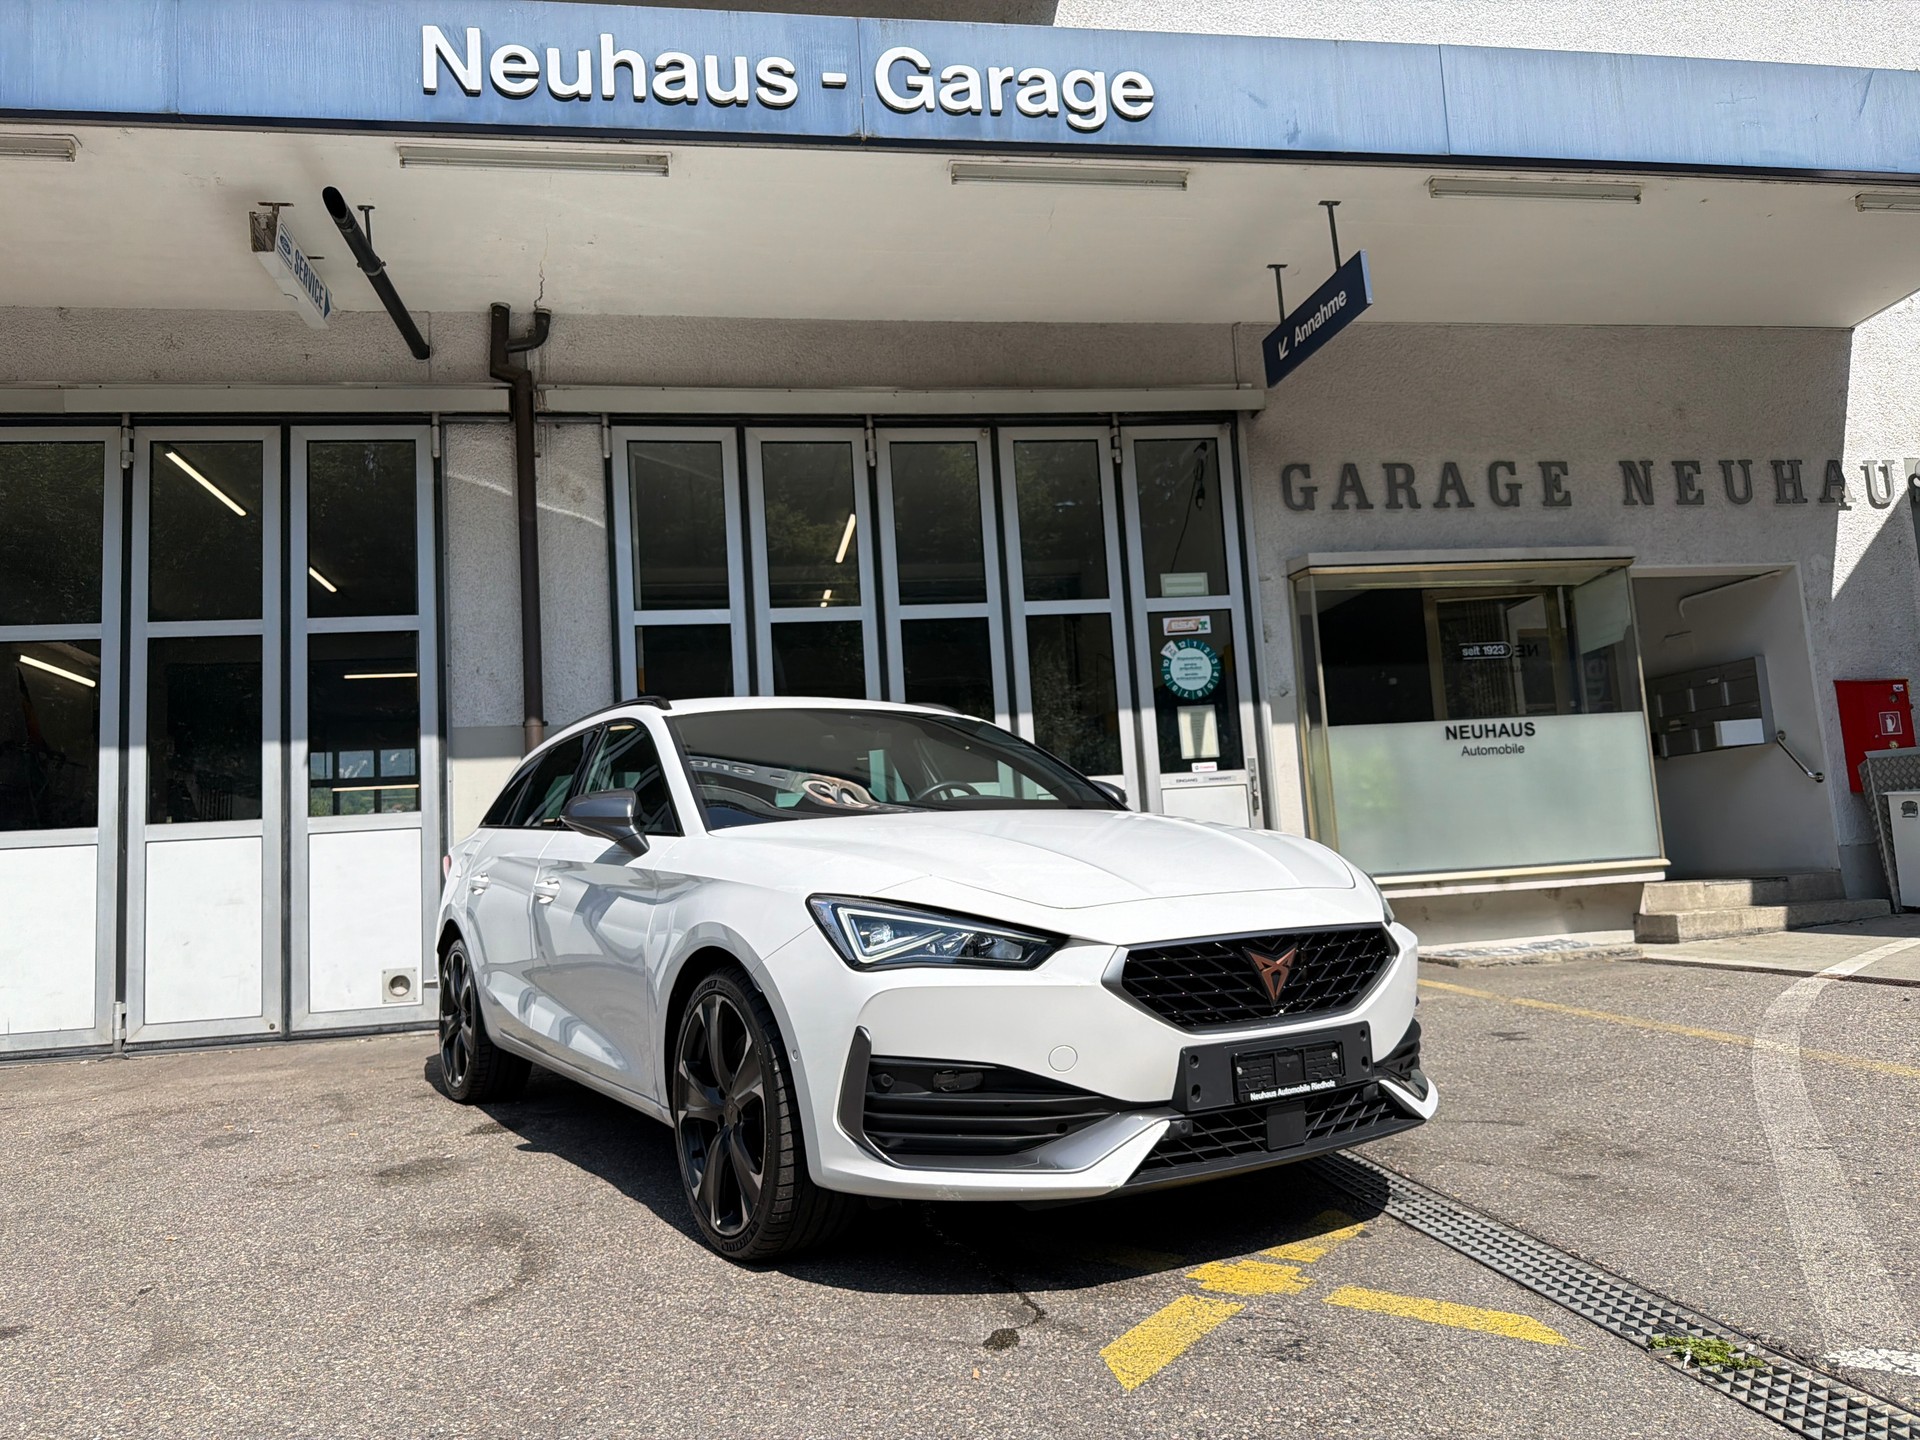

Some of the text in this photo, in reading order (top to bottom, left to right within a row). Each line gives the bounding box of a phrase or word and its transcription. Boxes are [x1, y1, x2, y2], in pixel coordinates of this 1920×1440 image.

[421, 25, 799, 108] Neuhaus
[874, 46, 1156, 132] Garage
[294, 249, 324, 310] SERVICE
[1294, 290, 1348, 348] Annahme
[1281, 457, 1920, 512] GARAGE NEUHAU
[1462, 645, 1505, 657] seit 1923
[1445, 722, 1536, 741] NEUHAUS
[1461, 743, 1525, 757] Automobile
[1250, 1080, 1336, 1101] Neuhaus Automobile Riedholz
